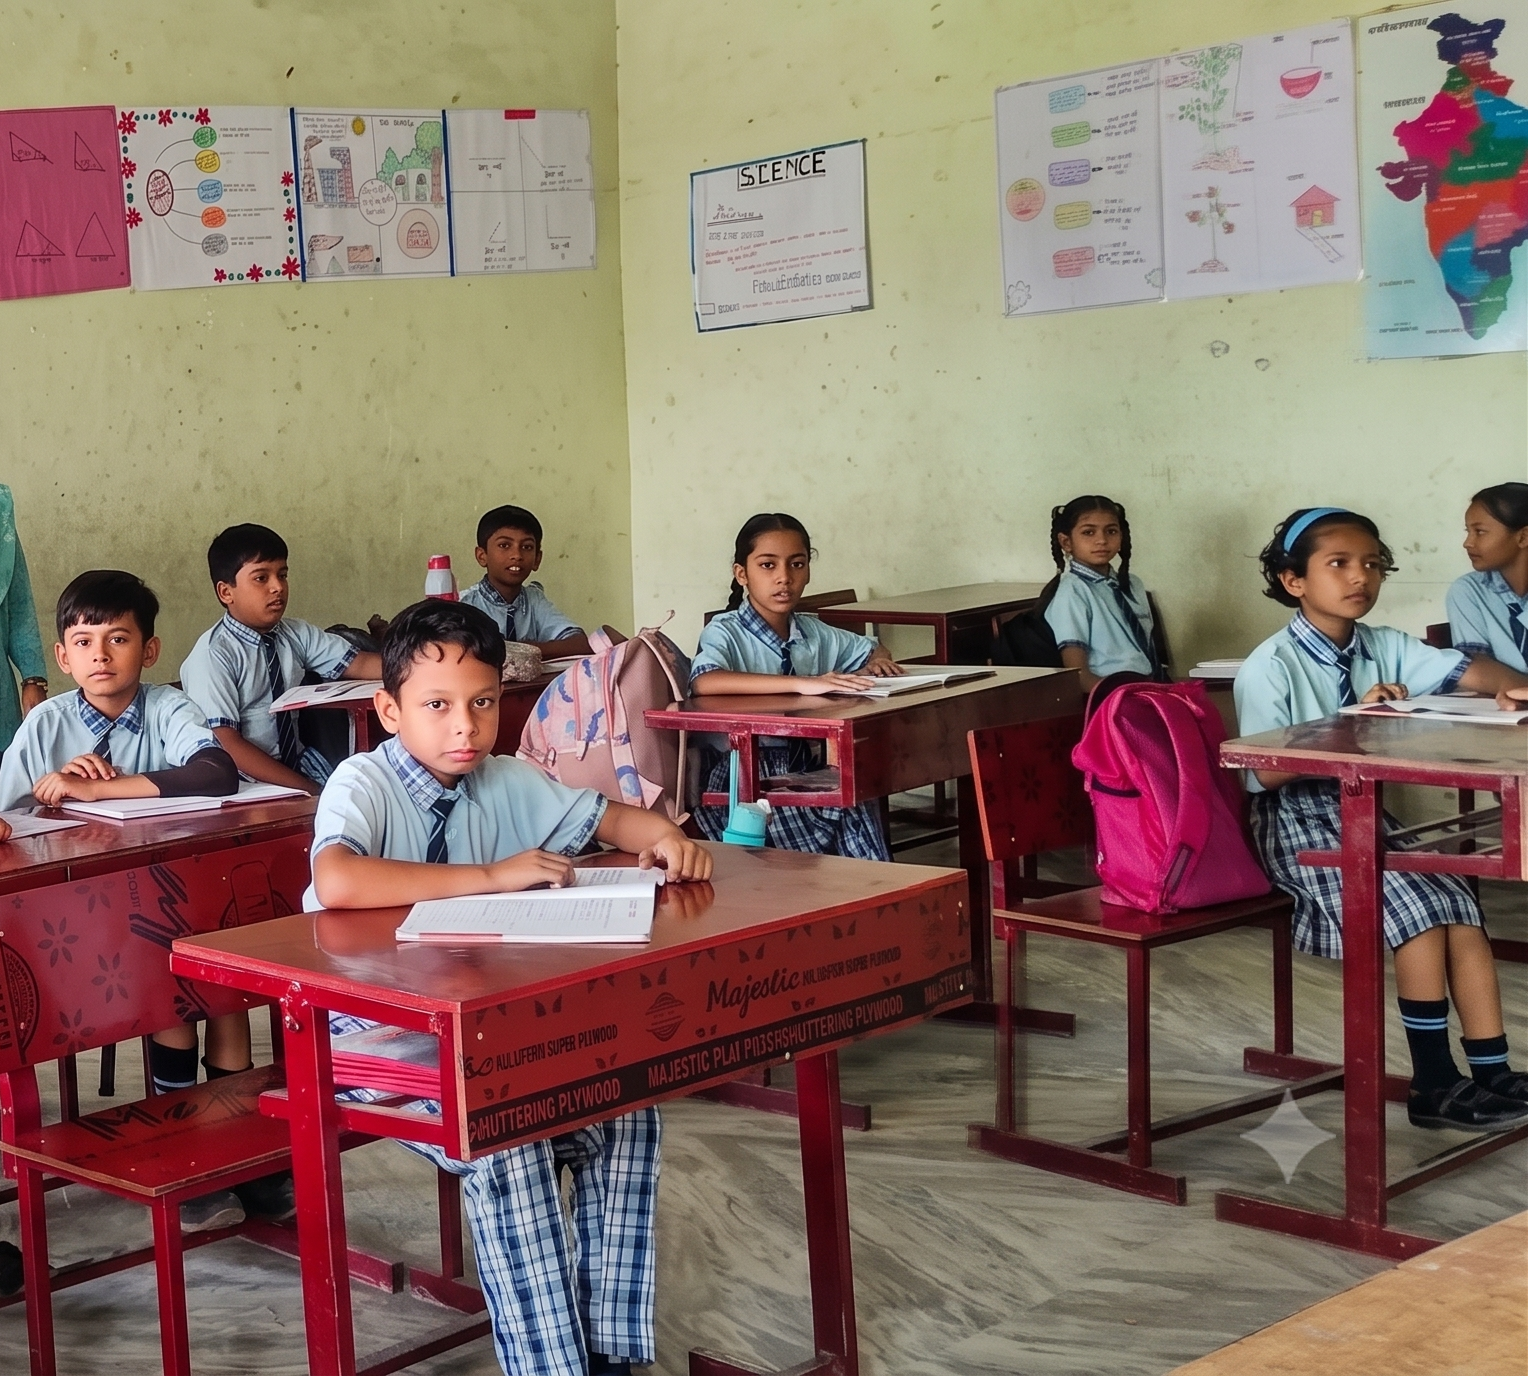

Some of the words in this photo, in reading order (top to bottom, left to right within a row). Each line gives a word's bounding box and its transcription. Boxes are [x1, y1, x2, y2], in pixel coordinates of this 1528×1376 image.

[706, 968, 800, 1019] Majestic
[547, 1034, 576, 1057] SUPER
[648, 1050, 710, 1088] MAJESTIC
[855, 994, 903, 1027] PLYWOOD
[559, 1078, 621, 1116] PLYWOOD
